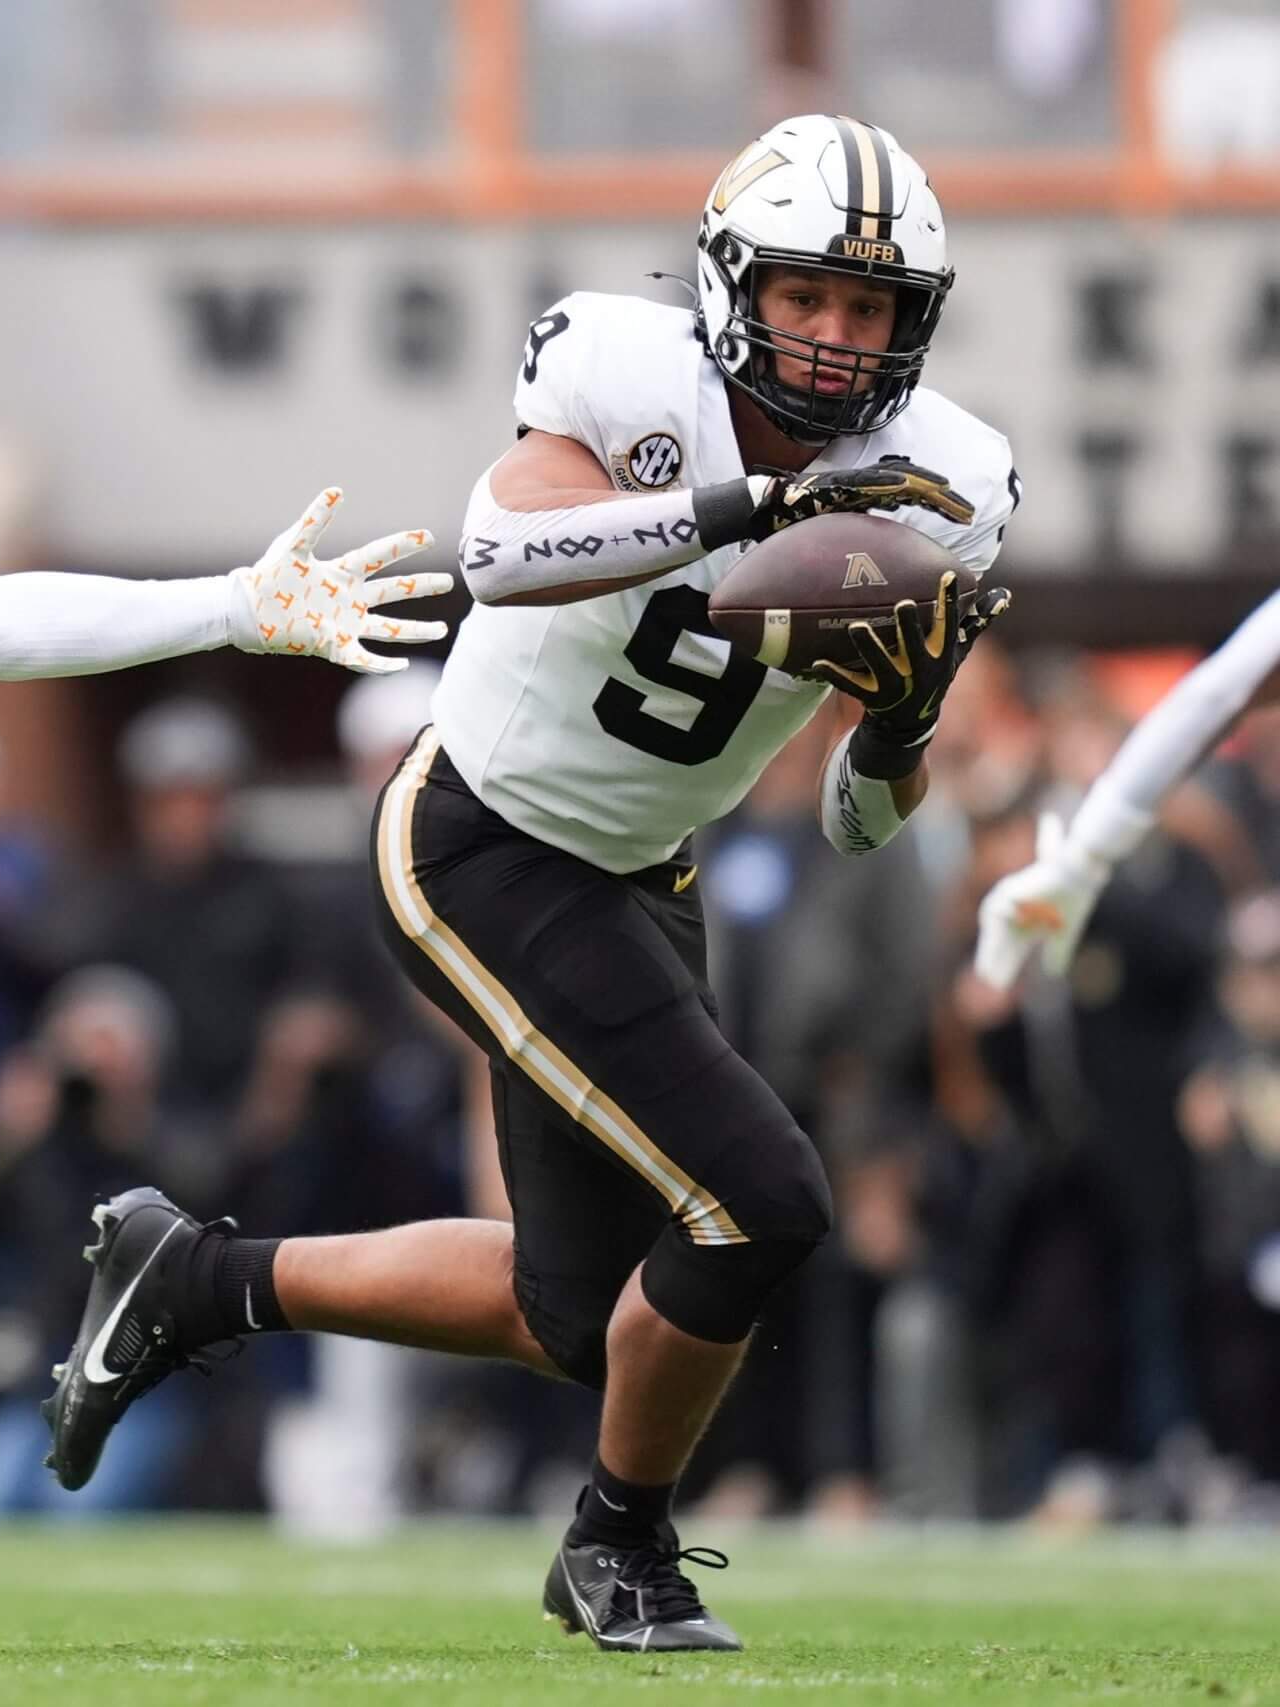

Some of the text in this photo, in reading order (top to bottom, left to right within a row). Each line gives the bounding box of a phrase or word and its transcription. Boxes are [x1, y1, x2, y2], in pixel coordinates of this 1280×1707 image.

[842, 239, 895, 262] VUFB
[631, 436, 680, 486] SEC
[592, 583, 768, 767] 9
